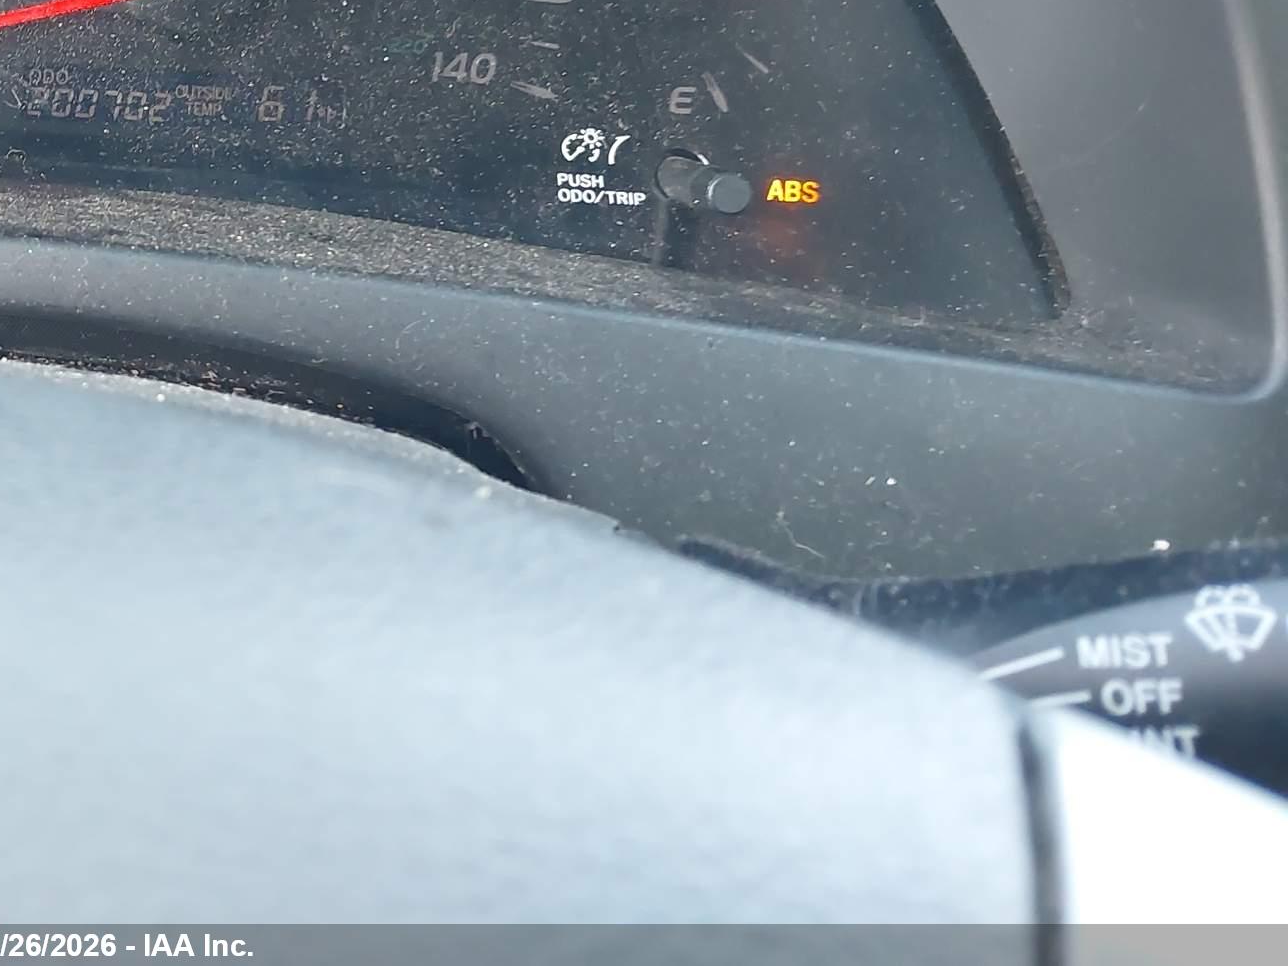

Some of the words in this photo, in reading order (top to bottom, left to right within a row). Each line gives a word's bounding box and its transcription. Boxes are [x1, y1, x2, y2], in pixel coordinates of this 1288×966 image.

[29, 68, 70, 85] ODO
[432, 51, 497, 85] 140
[669, 86, 697, 115] E
[557, 172, 605, 189] PUSH
[767, 179, 820, 204] ABS
[557, 189, 647, 207] ODO/TRIP
[1076, 634, 1173, 669] MIST
[1101, 678, 1182, 716] OFF
